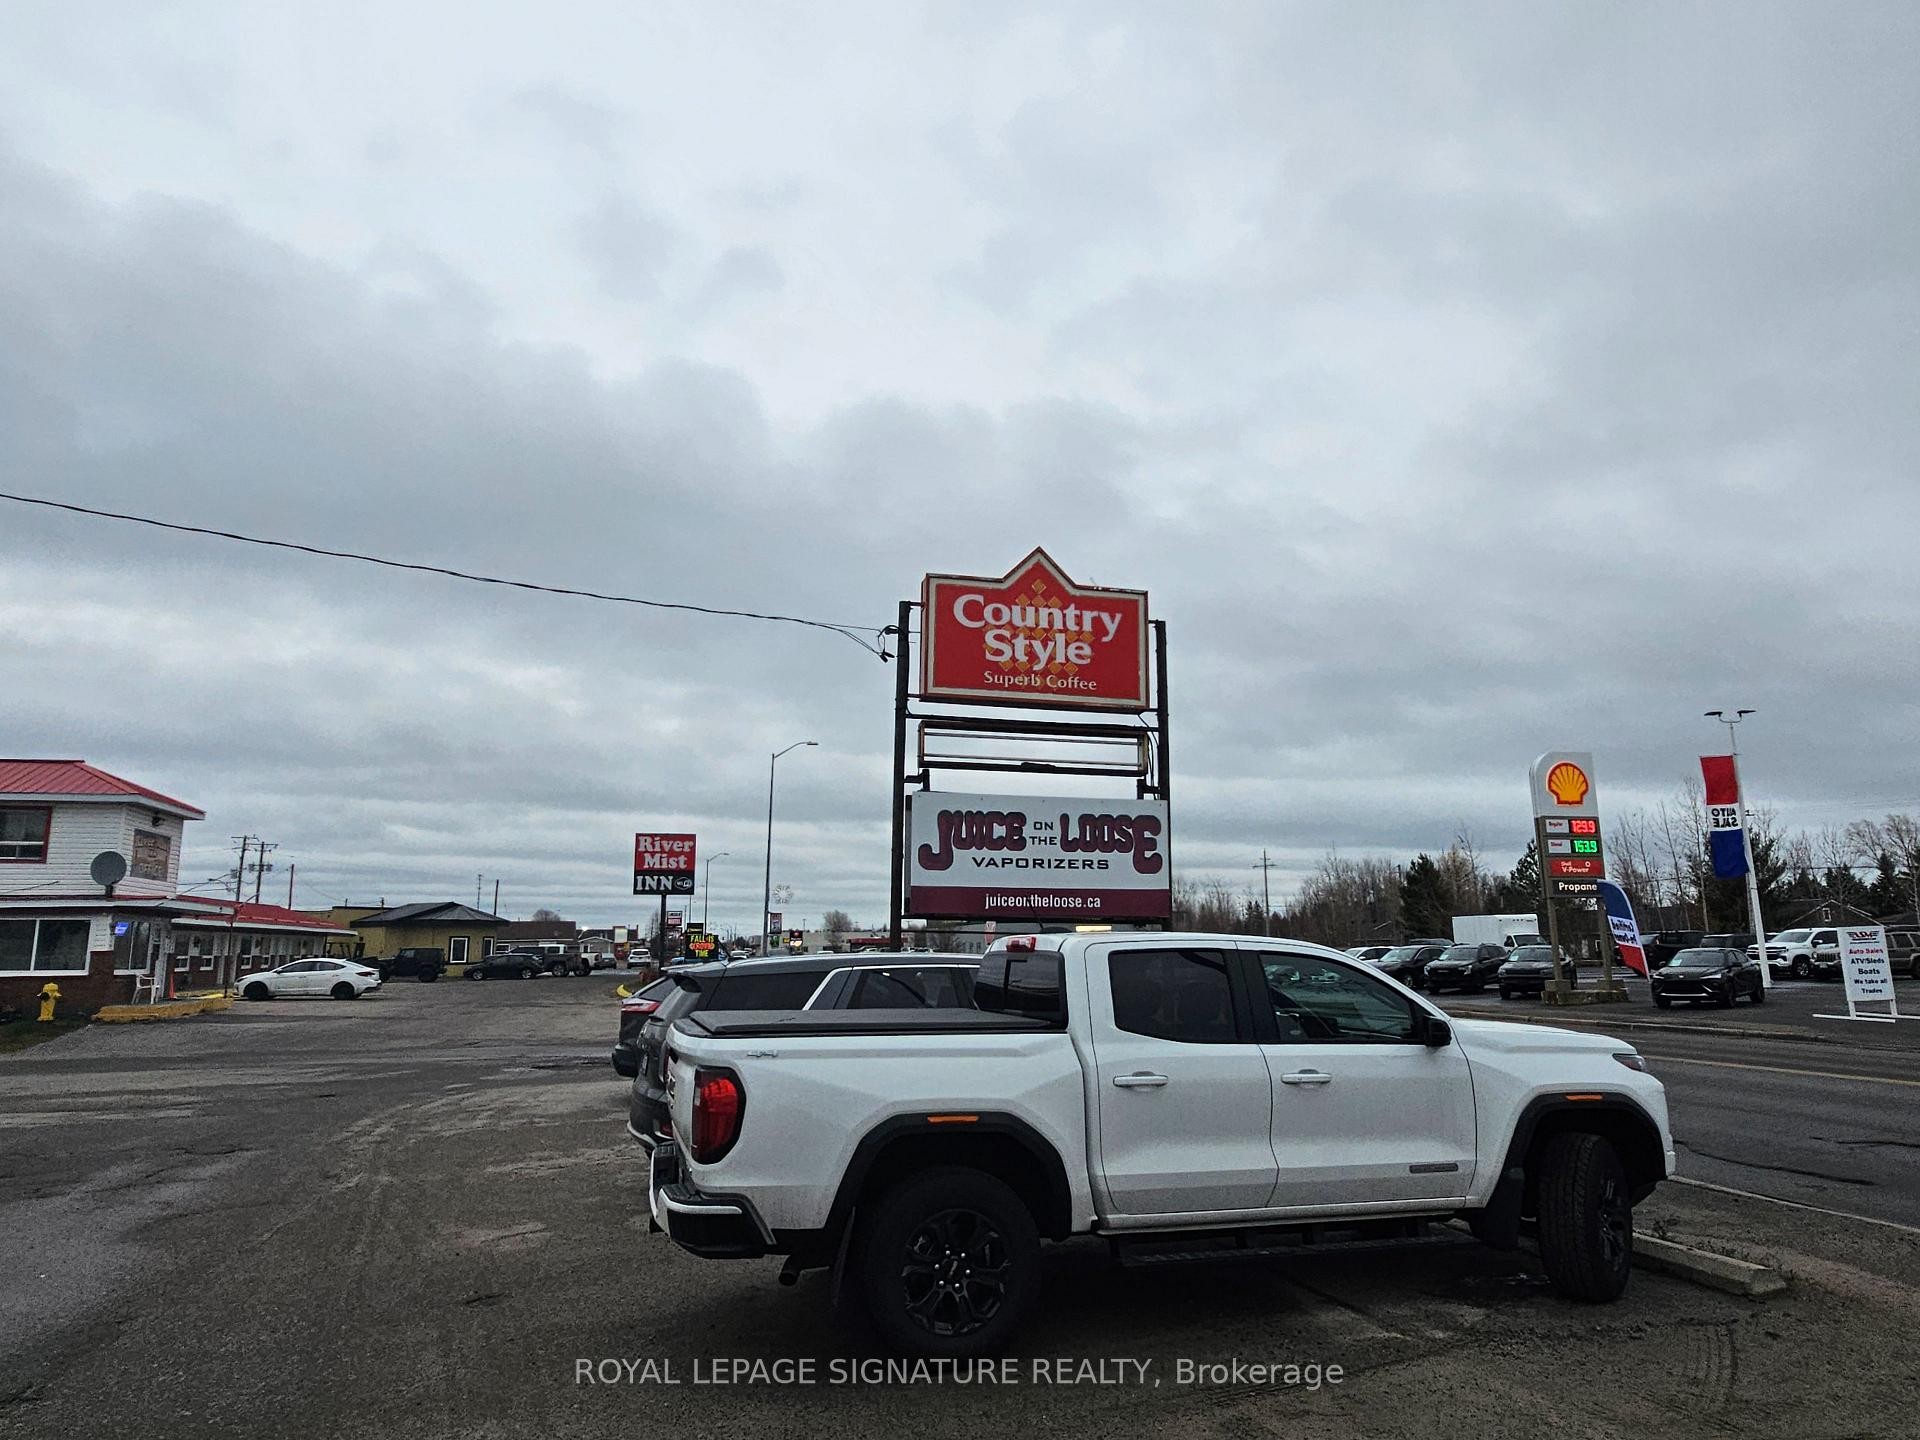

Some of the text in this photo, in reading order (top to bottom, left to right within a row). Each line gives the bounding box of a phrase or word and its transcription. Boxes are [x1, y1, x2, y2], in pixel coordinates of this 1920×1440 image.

[952, 593, 1123, 642] Country
[983, 628, 1093, 671] Style
[983, 670, 1098, 691] Superb Coffee
[638, 835, 694, 853] River
[918, 809, 1164, 875] JUICE ON THE LOOSE
[643, 852, 688, 869] Mist
[972, 856, 1112, 871] VAPORIZERS
[635, 875, 674, 891] INN
[1558, 881, 1598, 893] Propane
